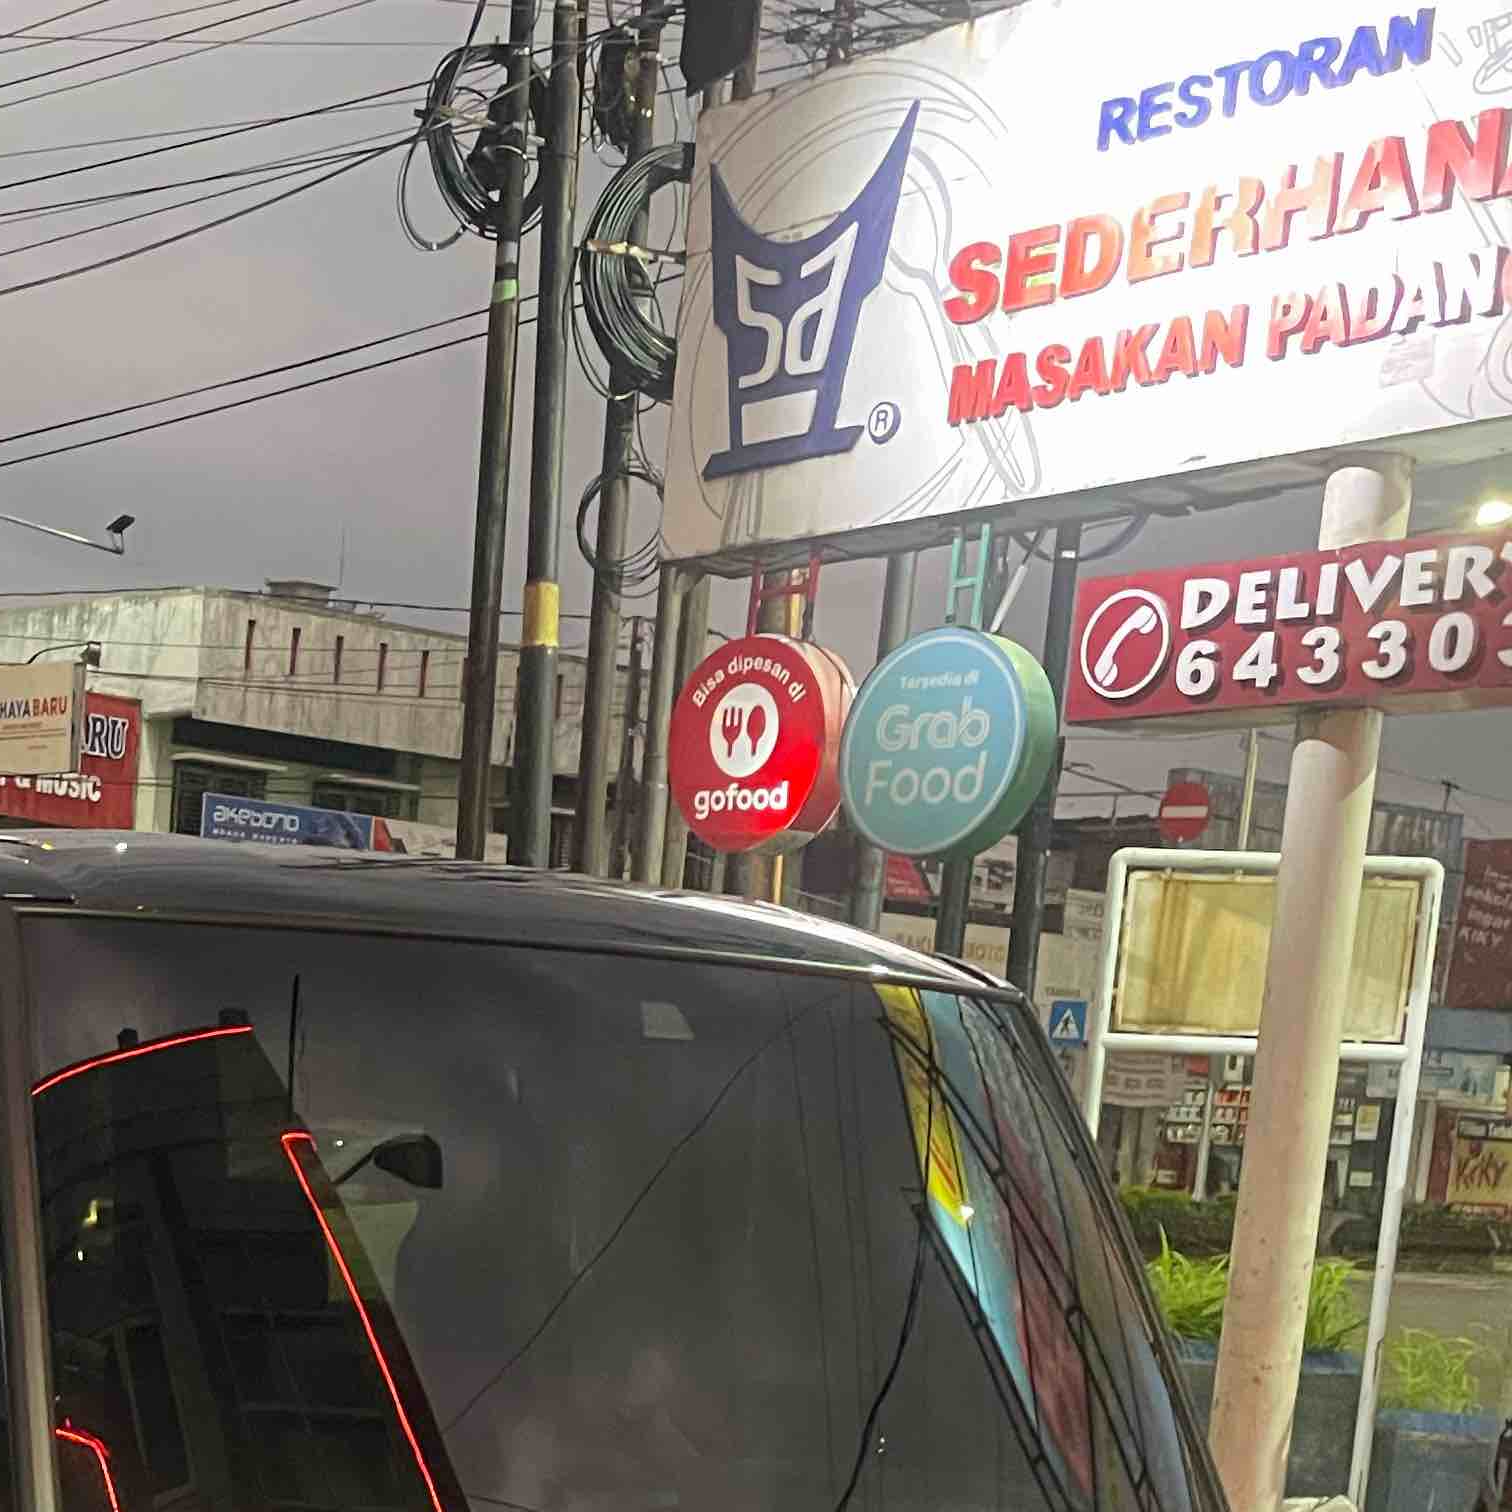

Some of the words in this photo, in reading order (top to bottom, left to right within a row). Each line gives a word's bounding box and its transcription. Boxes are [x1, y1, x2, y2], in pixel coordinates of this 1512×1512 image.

[1096, 6, 1436, 152] RESTORAN
[943, 107, 1512, 326] SEDERHAN
[946, 302, 1250, 428] MASAKAN
[1180, 541, 1512, 630] DELIVER
[32, 695, 68, 717] BARU
[691, 668, 726, 709] Bisa
[727, 654, 792, 686] dipesan
[787, 678, 808, 704] di
[81, 713, 129, 760] RU
[875, 695, 991, 751] Grab
[693, 780, 789, 821] gofood
[863, 752, 987, 807] Food
